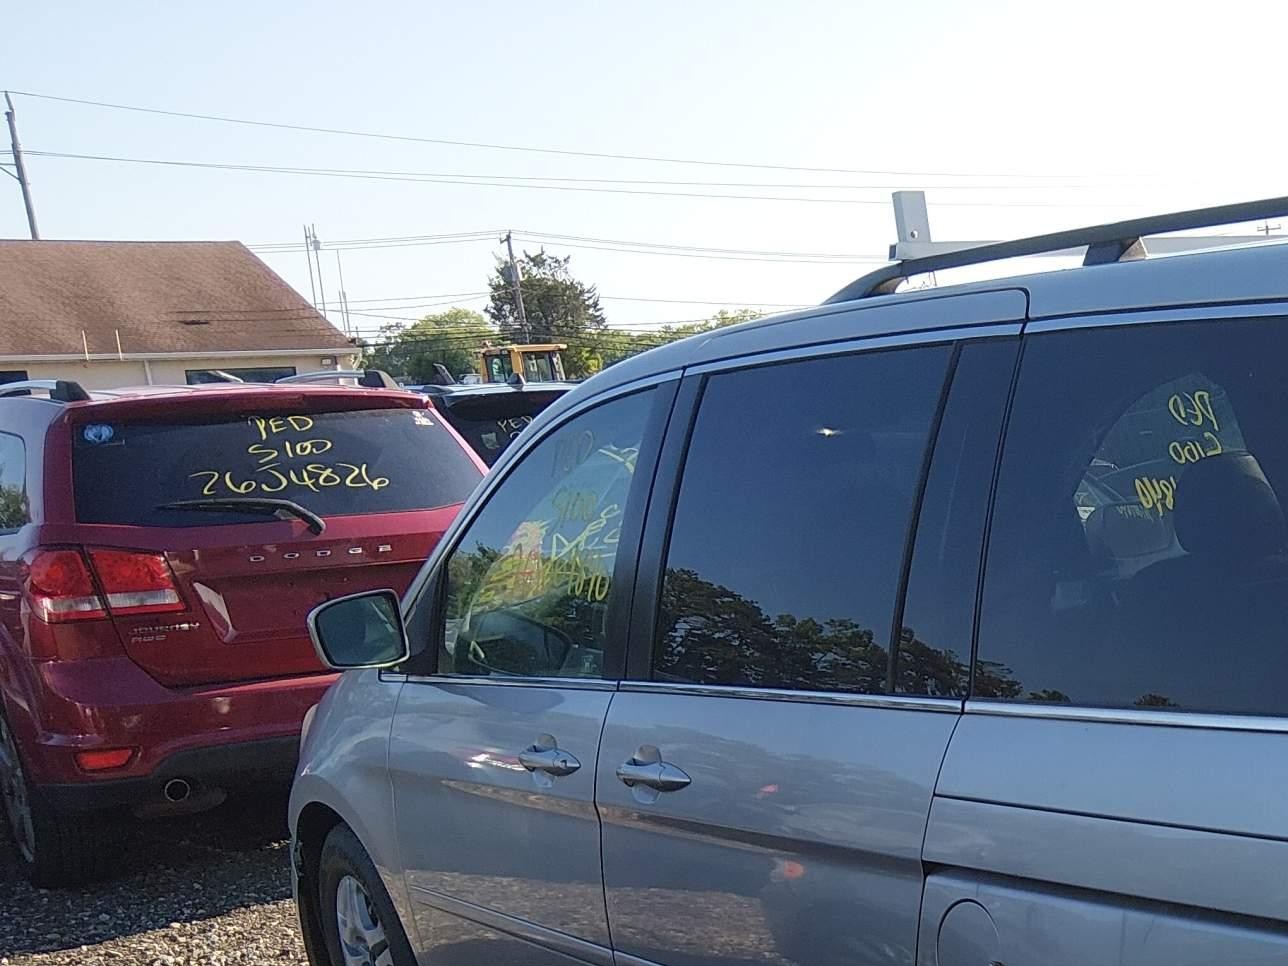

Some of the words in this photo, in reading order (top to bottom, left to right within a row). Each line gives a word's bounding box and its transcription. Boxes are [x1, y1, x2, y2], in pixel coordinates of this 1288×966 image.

[248, 439, 333, 464] S100
[189, 463, 390, 495] 26J4826
[249, 543, 392, 562] DODGE
